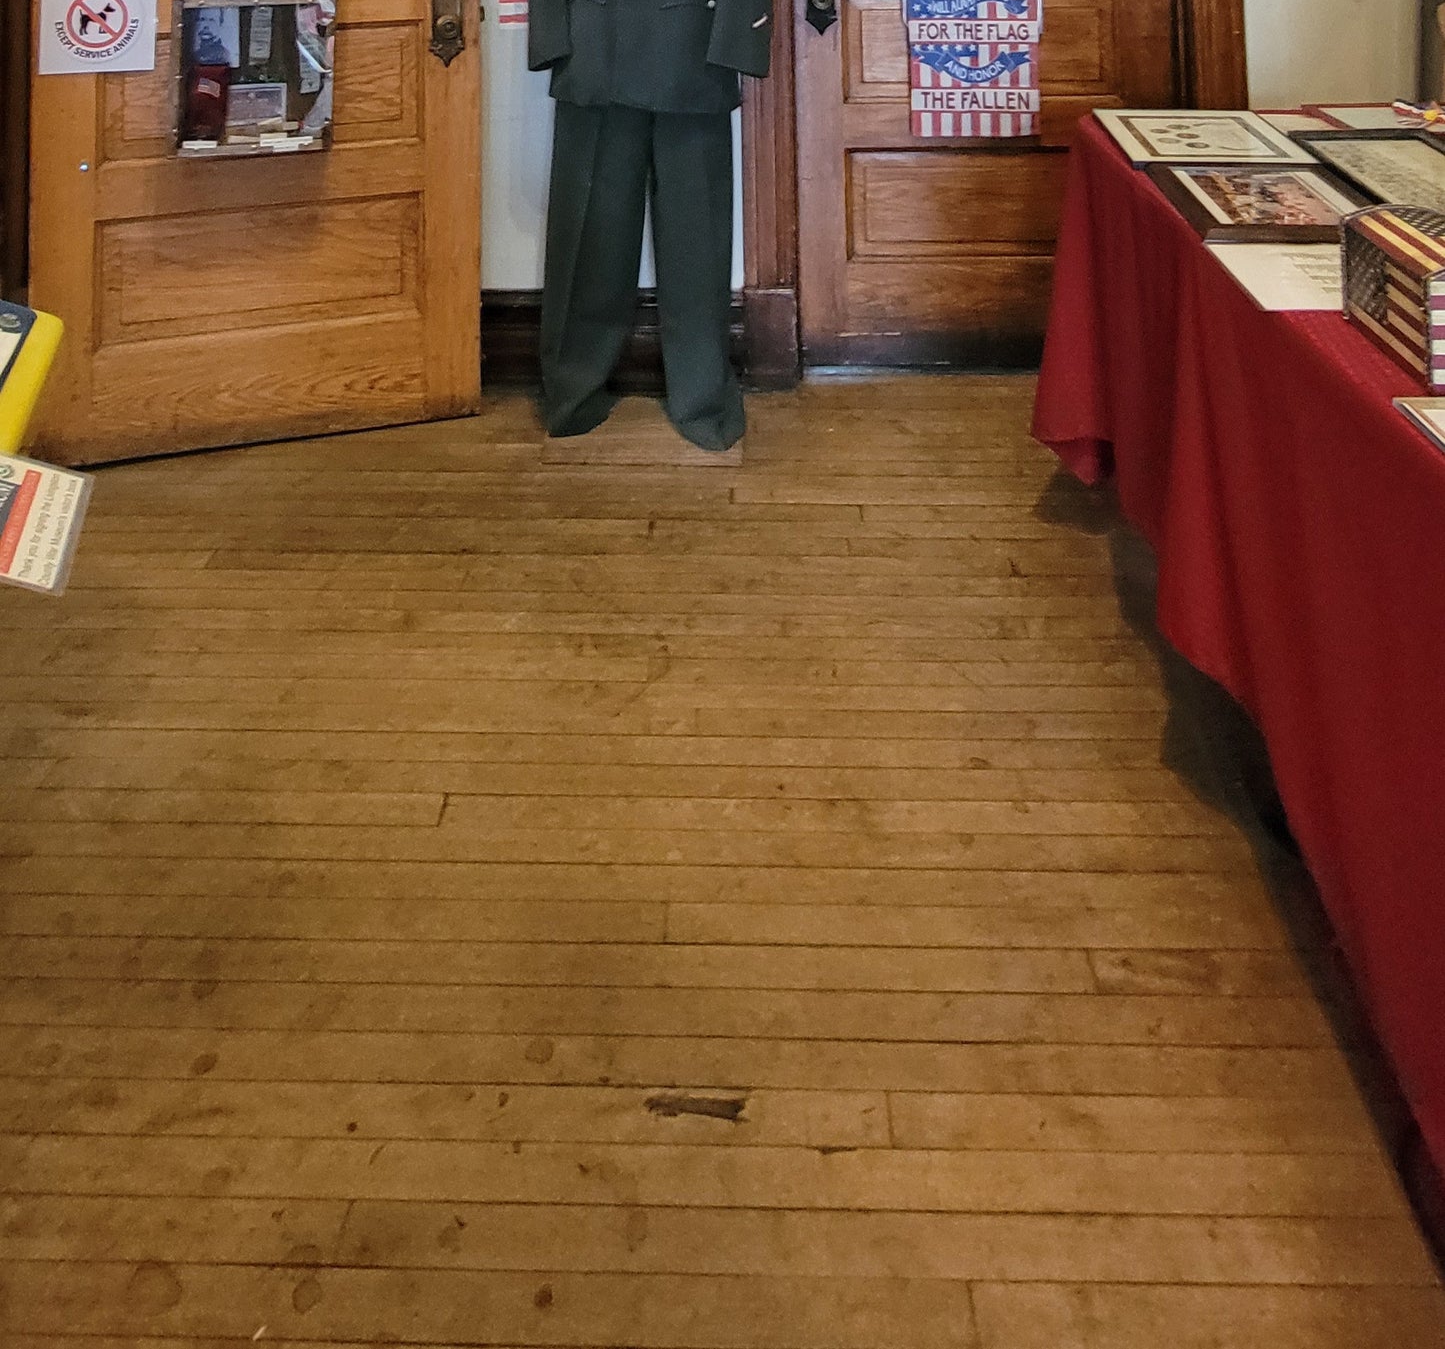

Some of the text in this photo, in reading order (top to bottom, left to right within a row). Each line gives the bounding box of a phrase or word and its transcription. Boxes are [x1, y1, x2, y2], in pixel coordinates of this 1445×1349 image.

[931, 0, 950, 13] WILL
[54, 18, 140, 59] EXCEPT SERVICE ANIMALS
[918, 22, 1030, 41] FOR THE FLAG
[944, 60, 1006, 82] AND HONOR
[921, 91, 1030, 110] THE FALLEN
